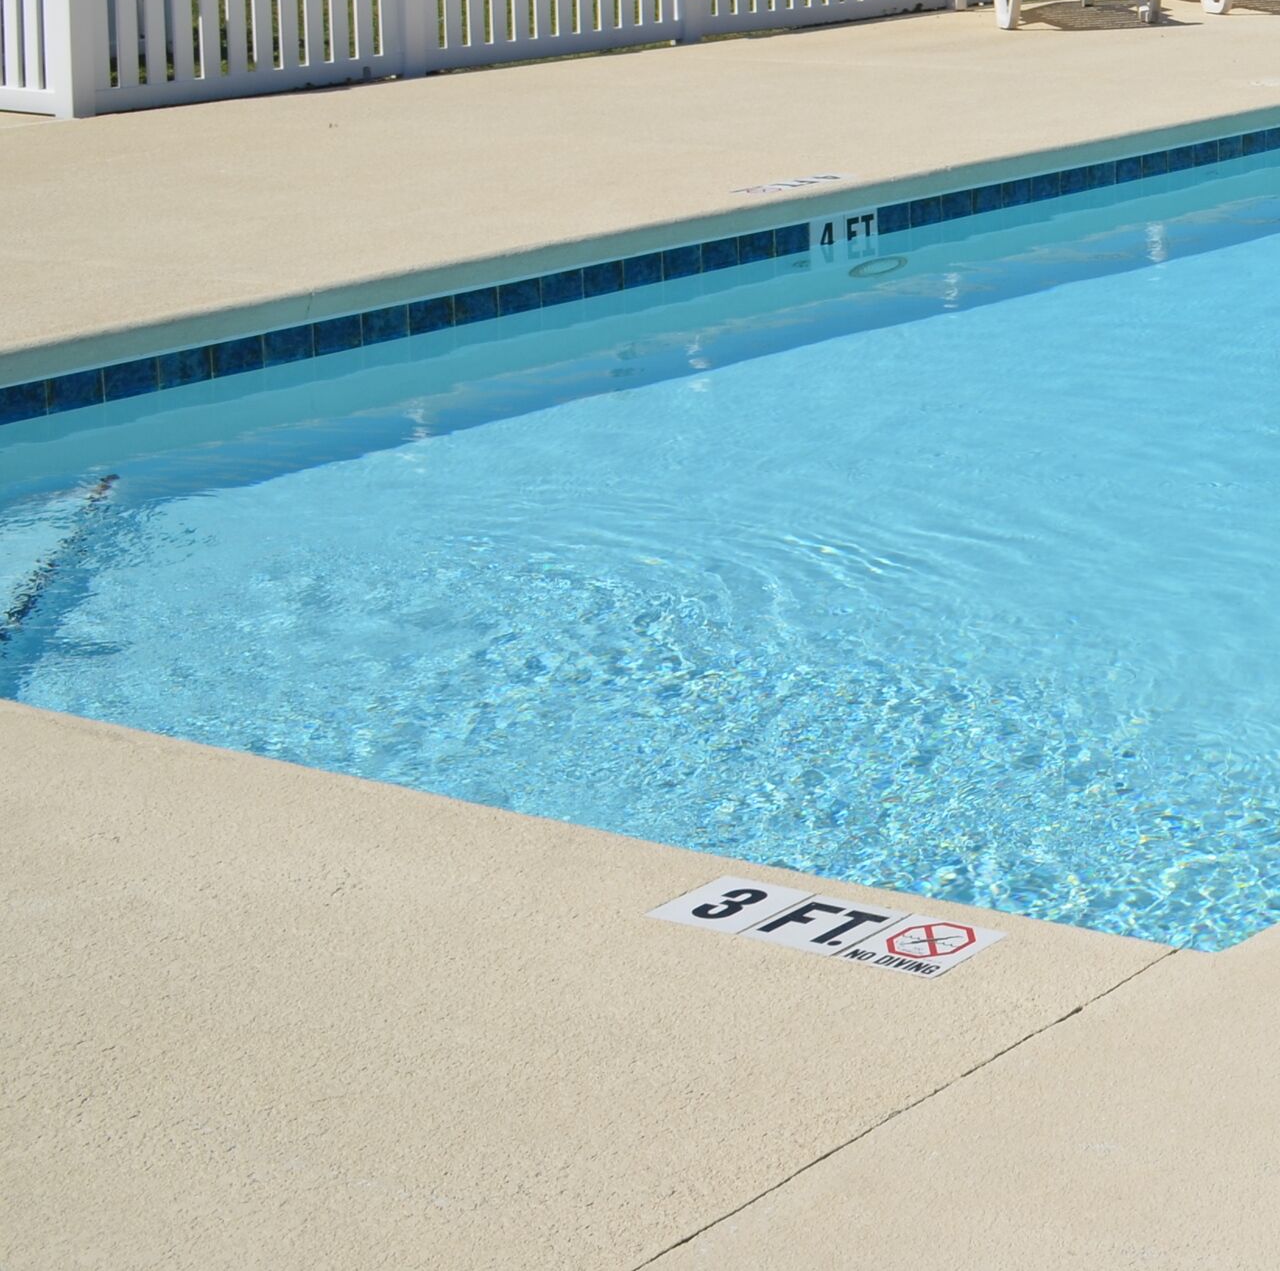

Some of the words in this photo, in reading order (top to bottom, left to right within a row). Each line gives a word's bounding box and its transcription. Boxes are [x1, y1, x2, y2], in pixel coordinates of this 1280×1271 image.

[820, 222, 834, 246] 4
[847, 213, 875, 242] FT
[691, 888, 768, 920] 3
[843, 948, 877, 961] NO
[873, 954, 941, 976] DIVING
